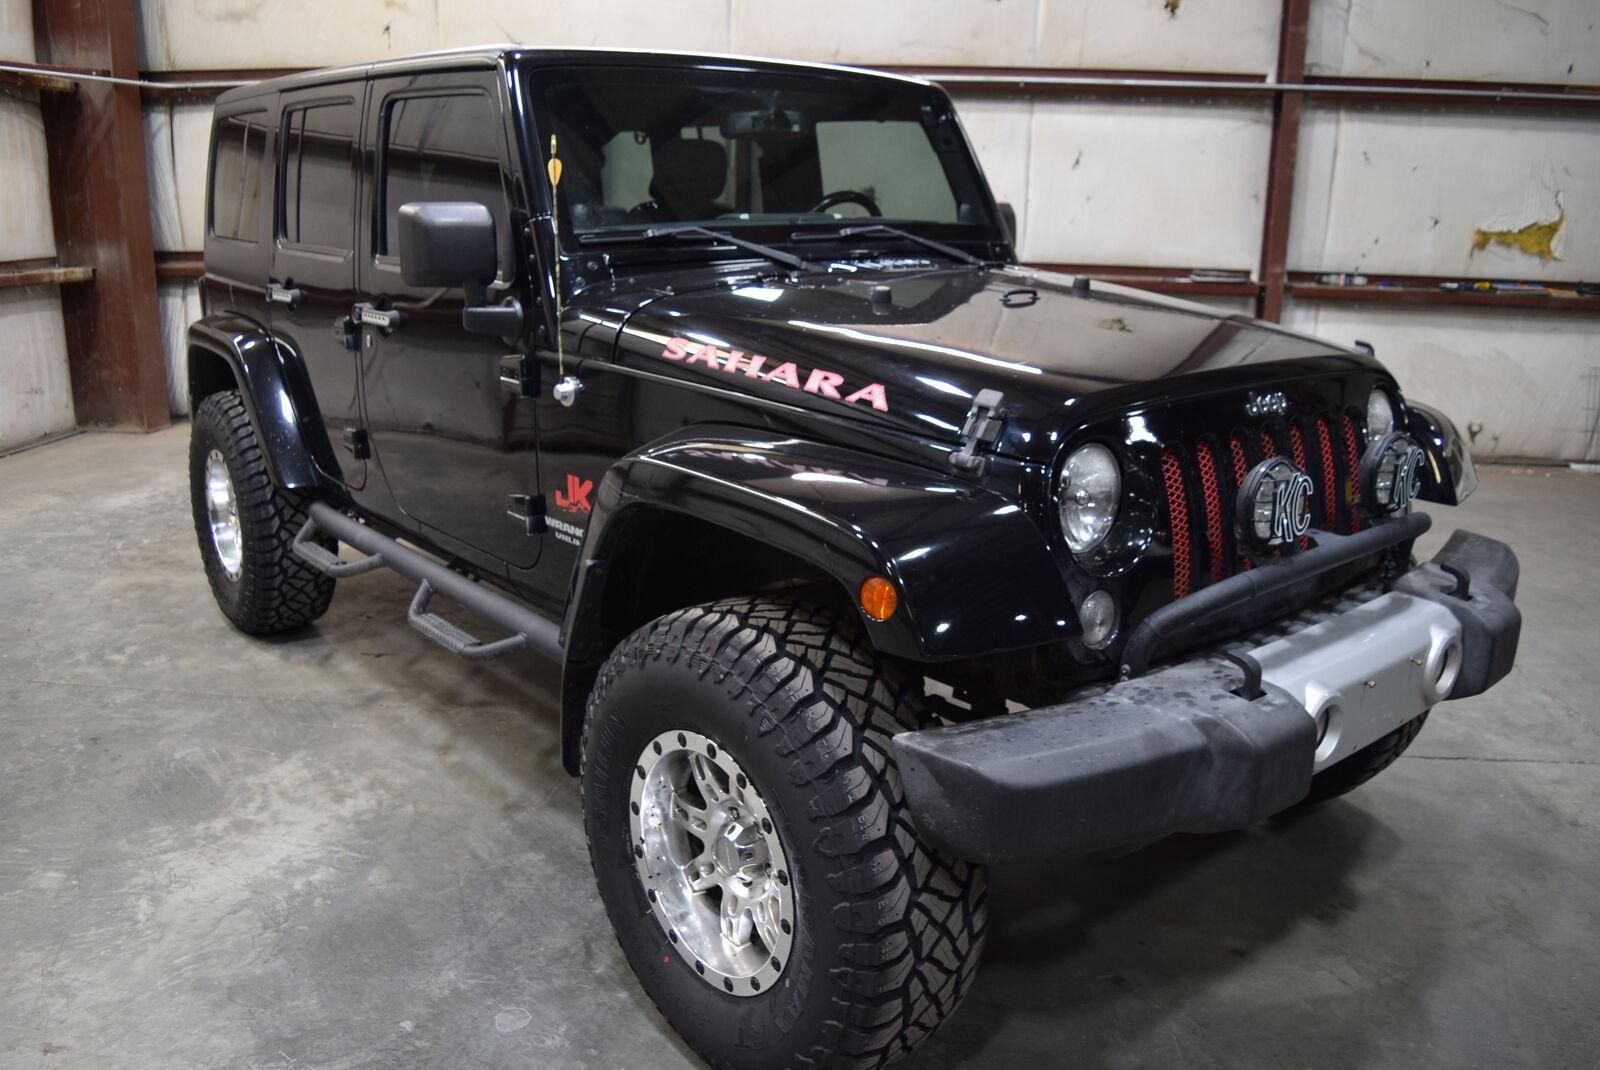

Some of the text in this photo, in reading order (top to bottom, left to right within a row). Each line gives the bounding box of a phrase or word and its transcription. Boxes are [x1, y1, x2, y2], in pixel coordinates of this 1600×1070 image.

[661, 336, 889, 413] SAHARA
[554, 473, 593, 513] JK
[1275, 472, 1313, 542] KC
[1394, 448, 1425, 507] KC
